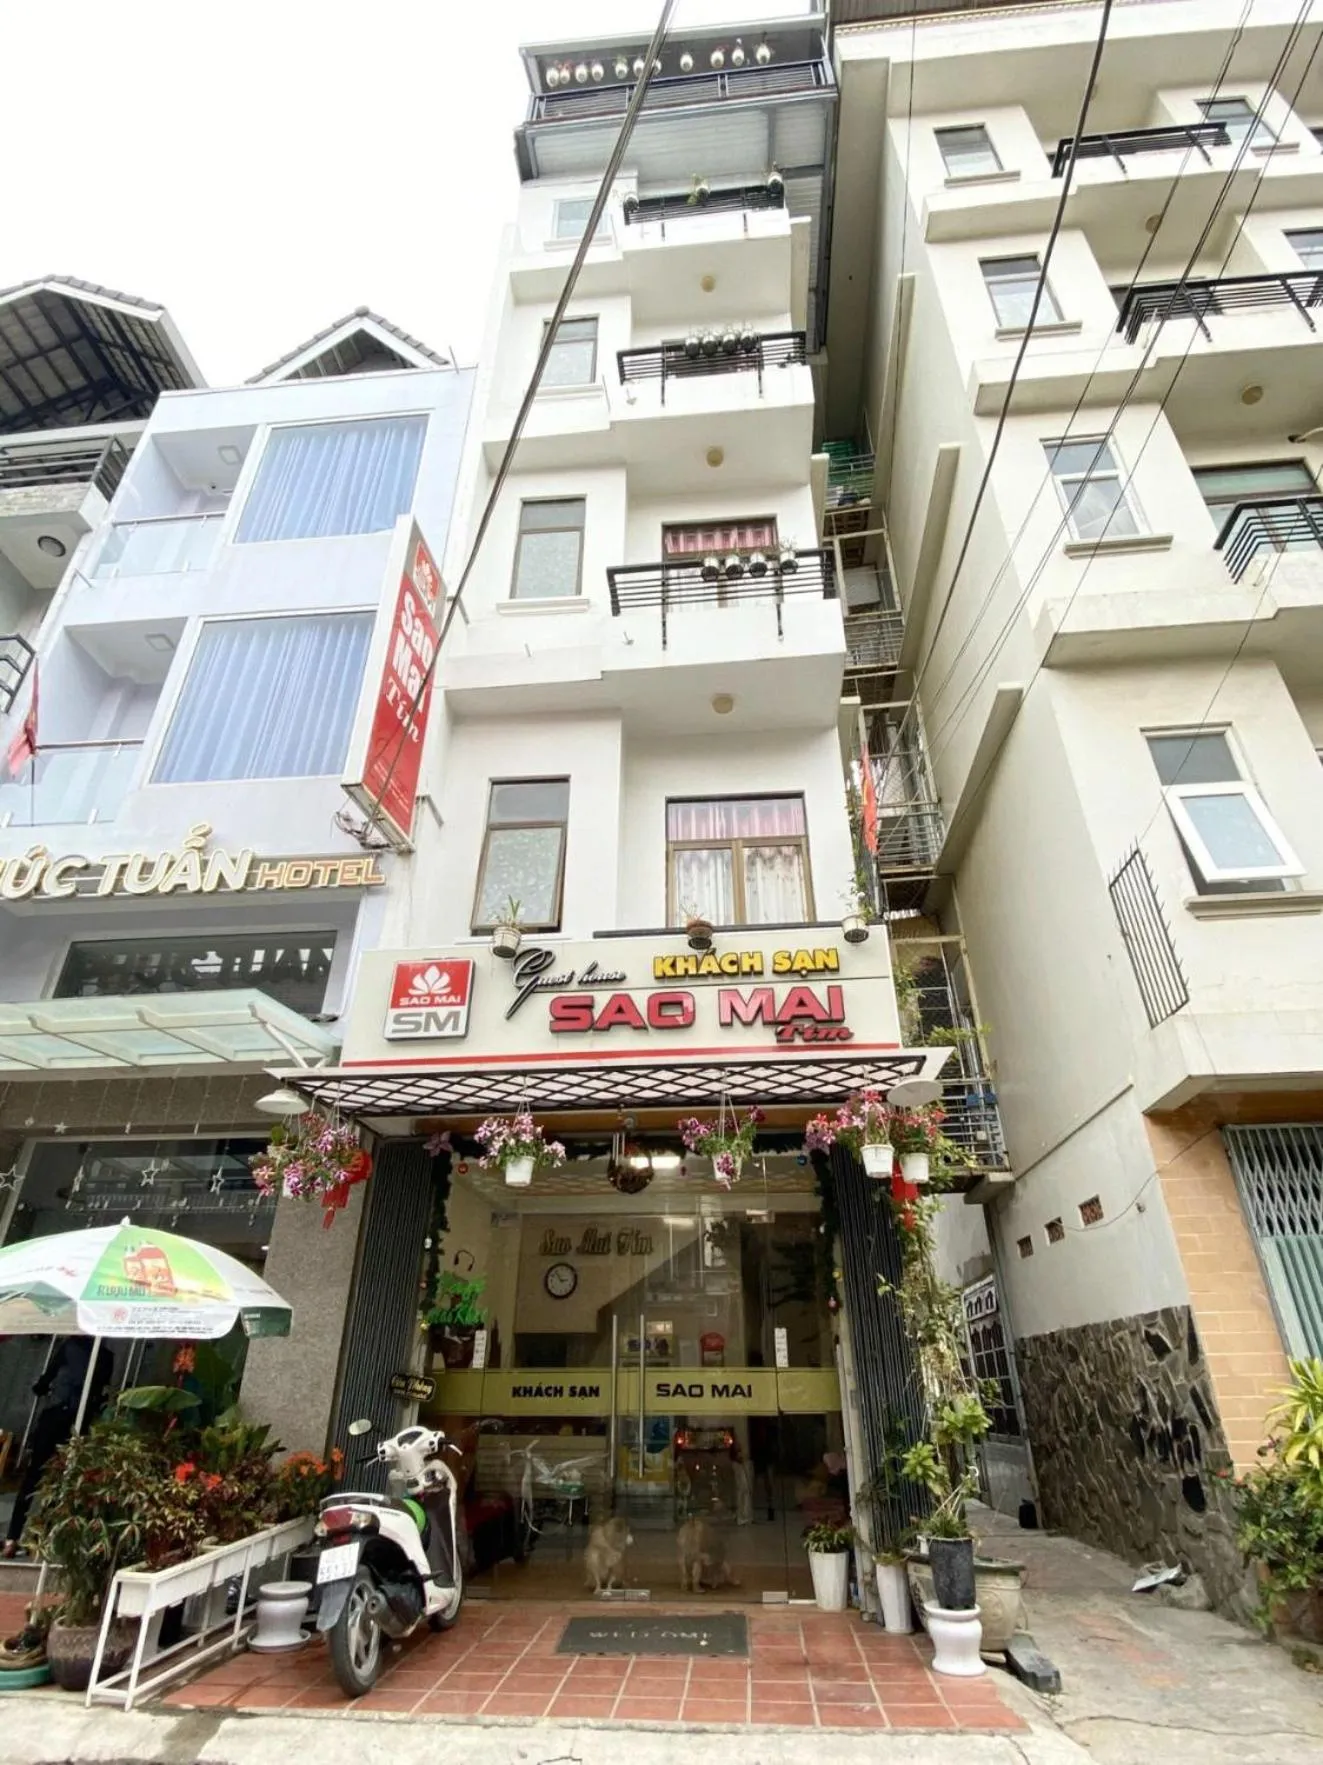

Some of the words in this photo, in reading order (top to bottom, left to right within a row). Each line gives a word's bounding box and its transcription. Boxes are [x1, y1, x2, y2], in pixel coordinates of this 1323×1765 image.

[401, 590, 434, 671] Sao
[392, 630, 428, 714] Mai
[98, 823, 254, 896] TUẤN
[255, 858, 385, 890] HOTEL
[506, 947, 576, 1020] Guest
[578, 959, 627, 986] house
[653, 948, 764, 979] KHÁCH
[772, 948, 840, 977] SẠN
[391, 1010, 462, 1034] SM
[399, 995, 431, 1006] SAO
[434, 994, 462, 1004] MAI
[548, 991, 696, 1034] SAO
[717, 985, 846, 1027] MAI
[511, 1381, 564, 1398] KHÁCH
[568, 1385, 600, 1402] SẠN
[656, 1383, 704, 1398] SAO
[711, 1383, 753, 1398] MAI
